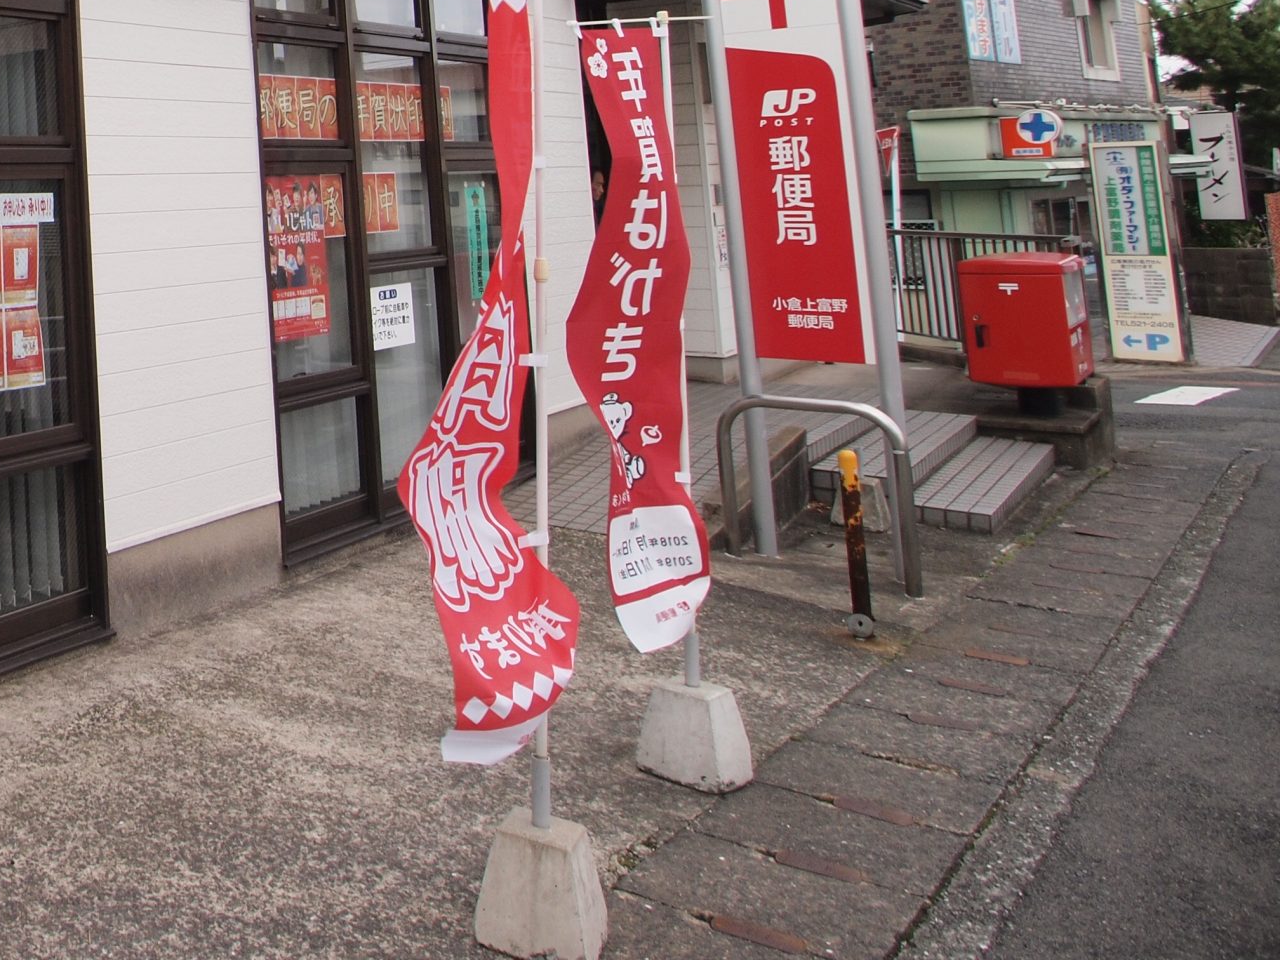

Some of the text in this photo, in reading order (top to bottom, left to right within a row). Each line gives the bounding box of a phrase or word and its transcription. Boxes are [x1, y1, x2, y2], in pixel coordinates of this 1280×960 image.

[759, 117, 814, 128] POST
[768, 135, 818, 246] 郵便局
[772, 296, 848, 314] 小倉上富野
[787, 313, 835, 330] 郵便局
[1145, 333, 1170, 351] P
